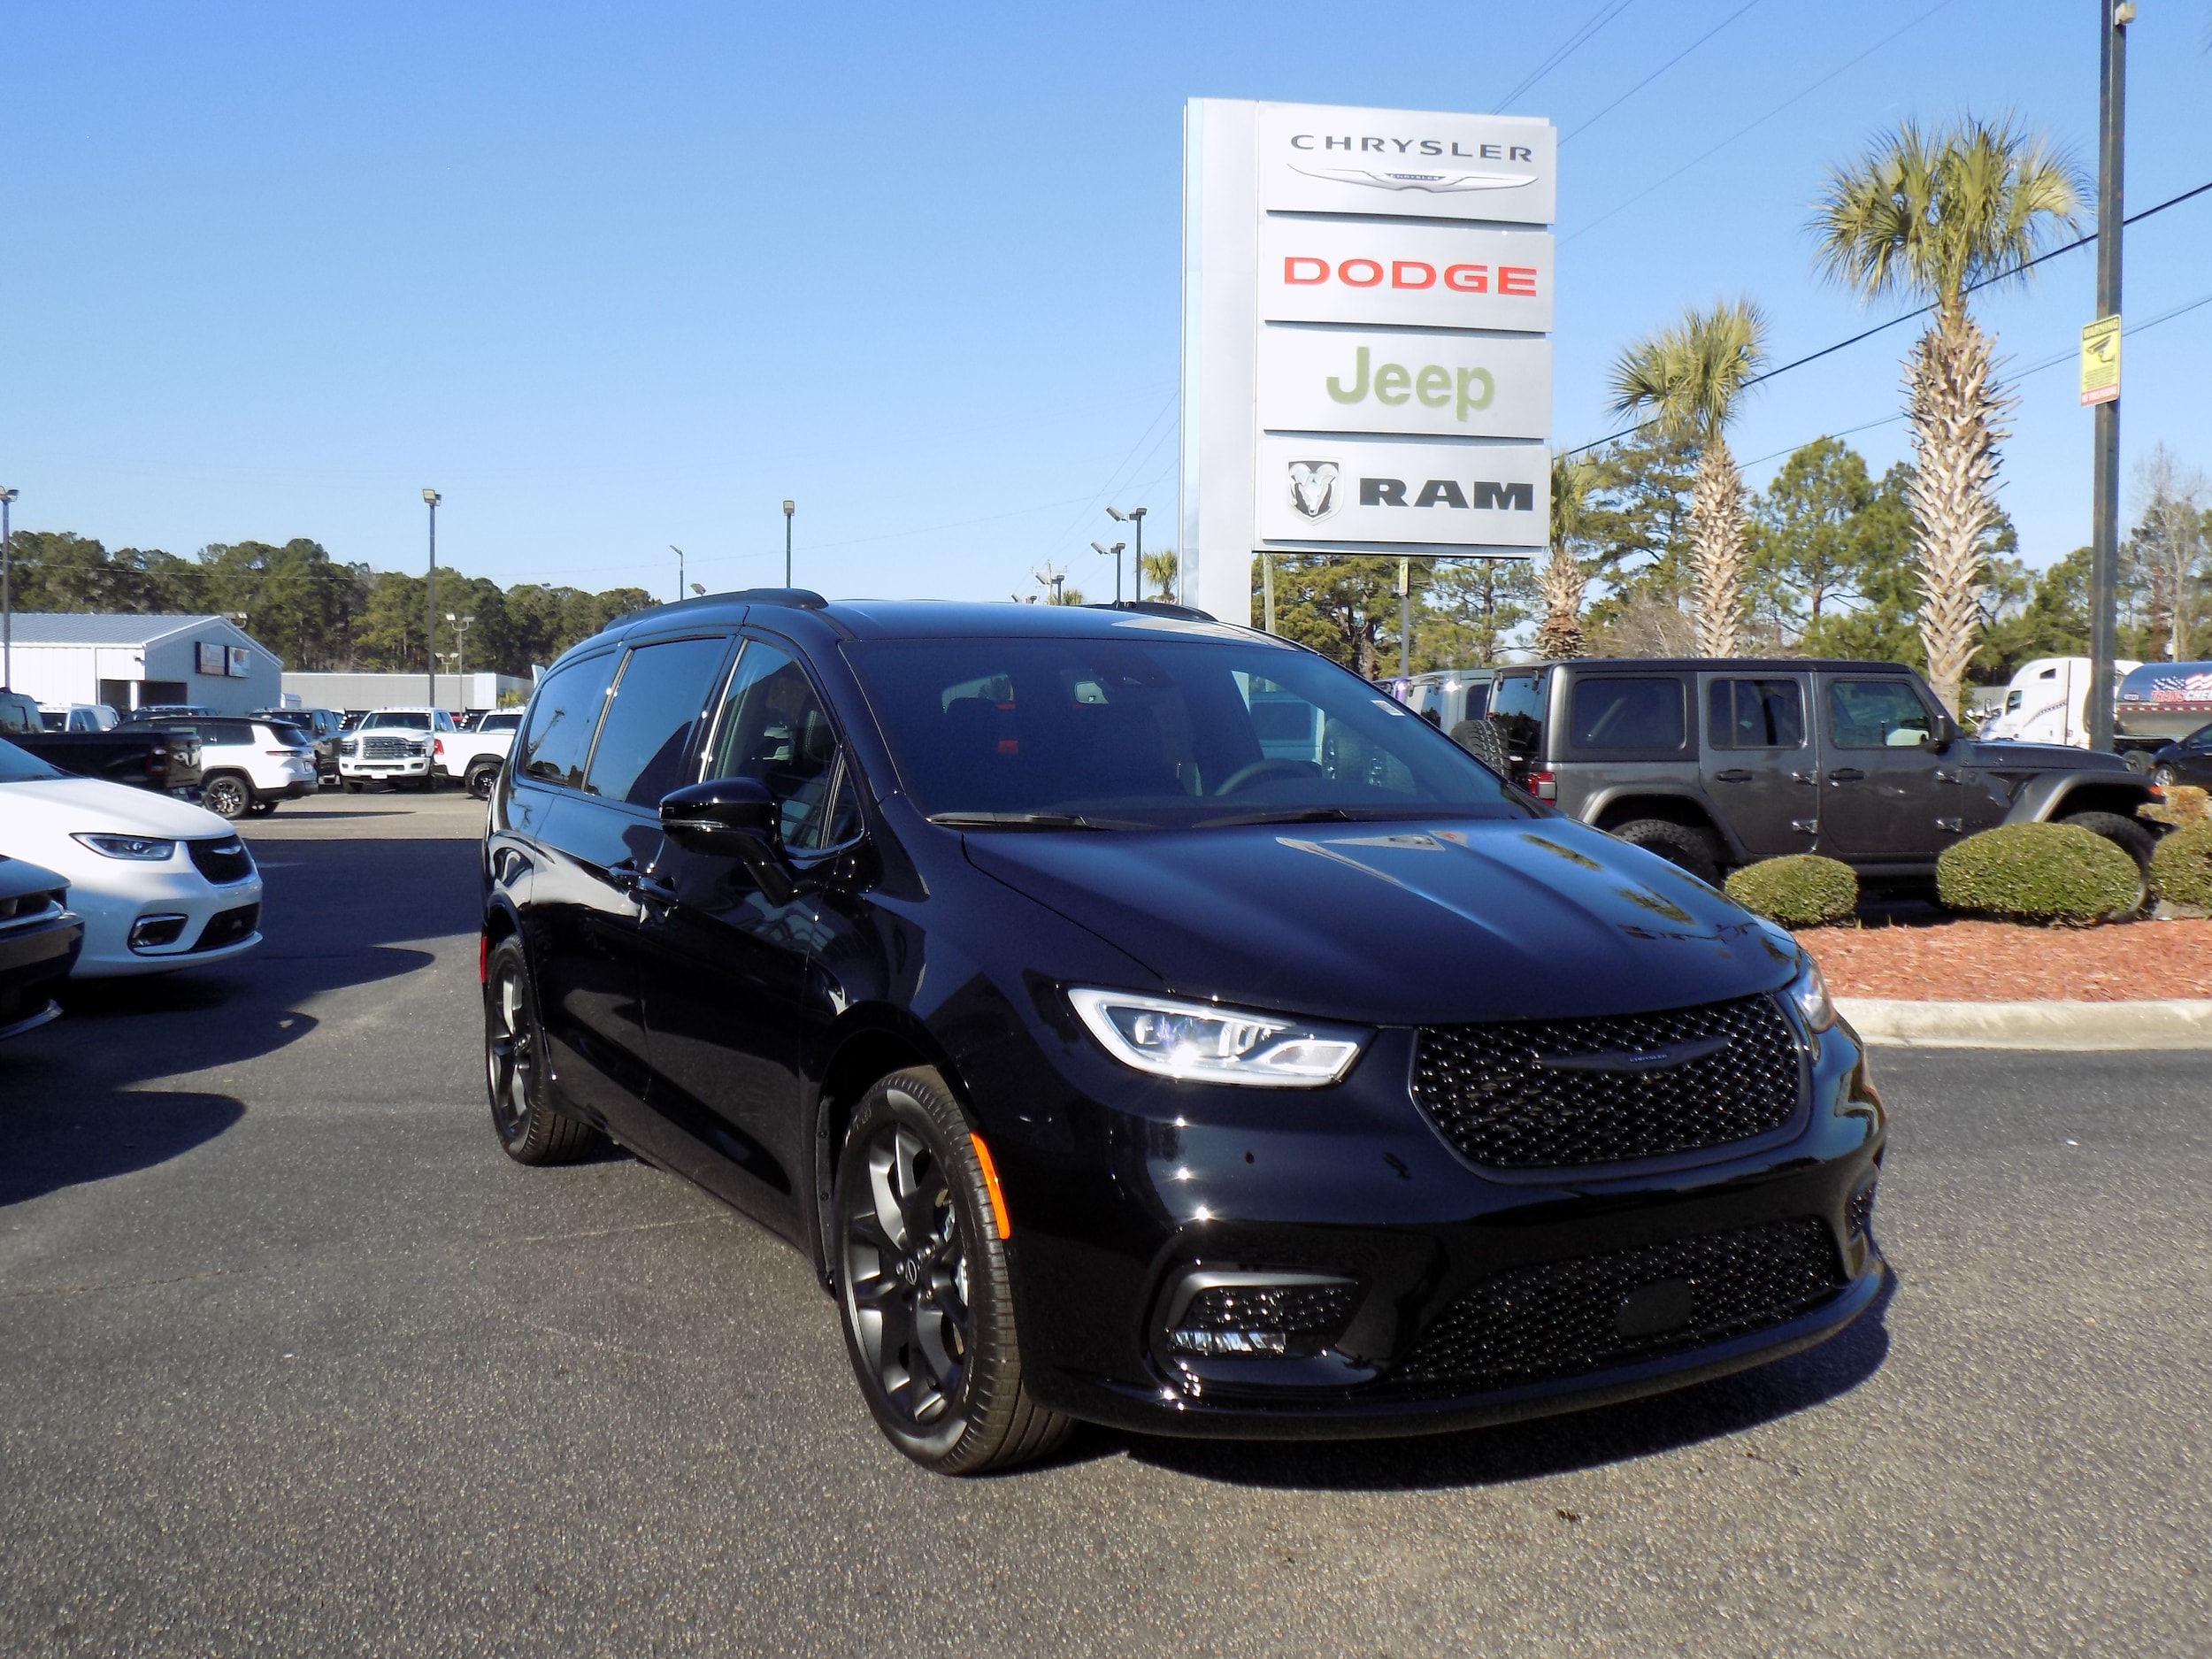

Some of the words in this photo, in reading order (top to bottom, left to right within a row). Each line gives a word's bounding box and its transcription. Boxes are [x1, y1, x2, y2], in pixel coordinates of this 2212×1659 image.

[1290, 134, 1532, 163] CHRYSLER
[1284, 257, 1537, 296] DODGE
[1326, 346, 1494, 422] Jeep
[1359, 478, 1533, 511] RAM
